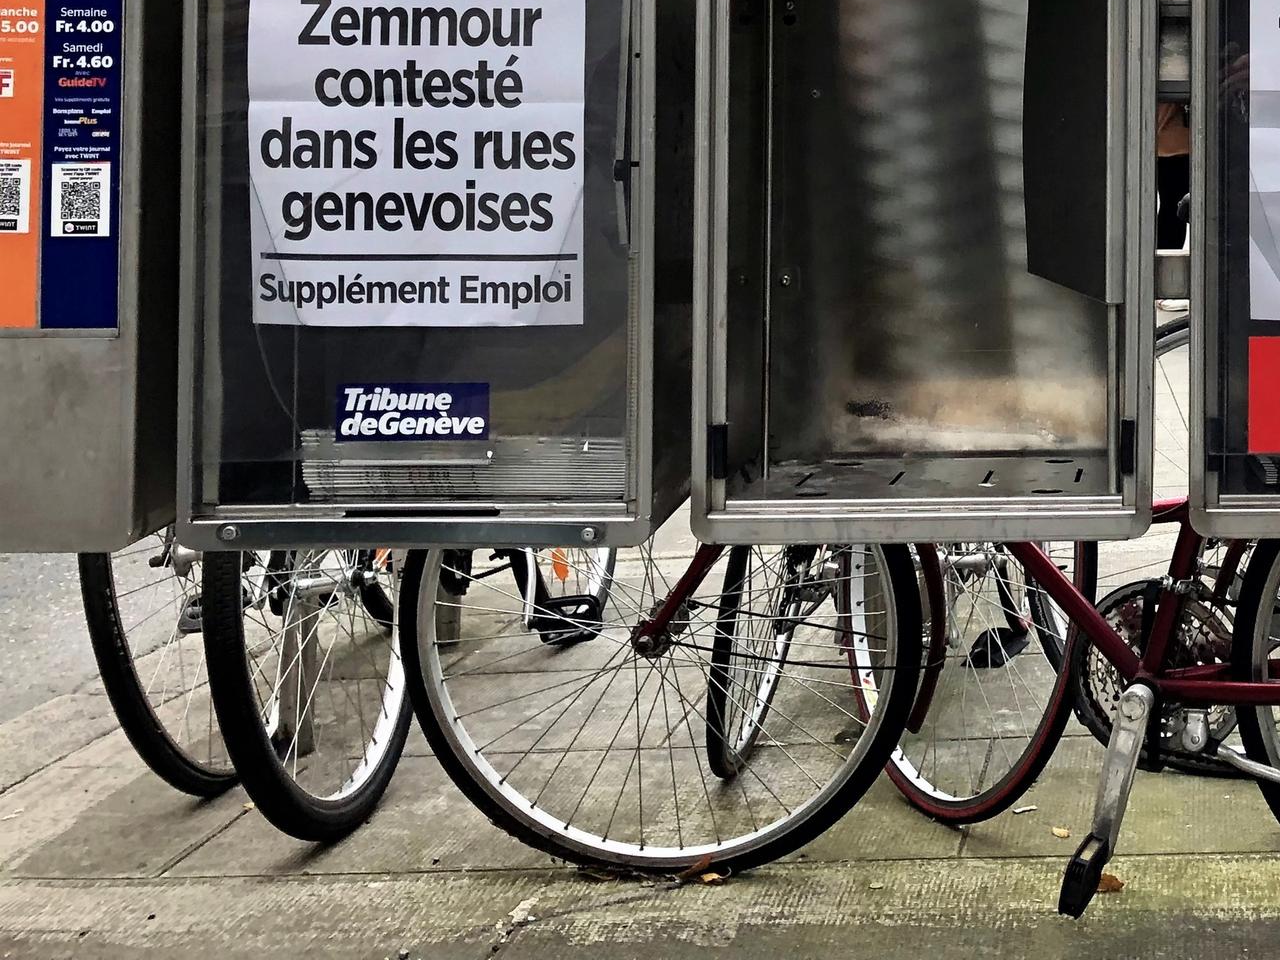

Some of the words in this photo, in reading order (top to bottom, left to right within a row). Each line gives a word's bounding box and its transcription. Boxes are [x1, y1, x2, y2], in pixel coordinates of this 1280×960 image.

[60, 6, 108, 18] Semaine
[0, 20, 40, 33] 5.00
[55, 19, 75, 33] Fr.
[76, 19, 115, 33] 4.00
[62, 42, 103, 53] Samedi
[52, 55, 75, 68] Fr.
[76, 55, 114, 69] 4.60
[57, 77, 107, 88] GuideTV
[315, 54, 523, 108] contesté
[261, 117, 377, 169] dans
[394, 118, 458, 169] les
[475, 127, 575, 170] rues
[282, 180, 553, 240] genevoises
[260, 273, 449, 309] Supplément
[462, 273, 571, 309] Emploi
[345, 388, 452, 411] Tribune
[341, 409, 484, 435] deGenève
